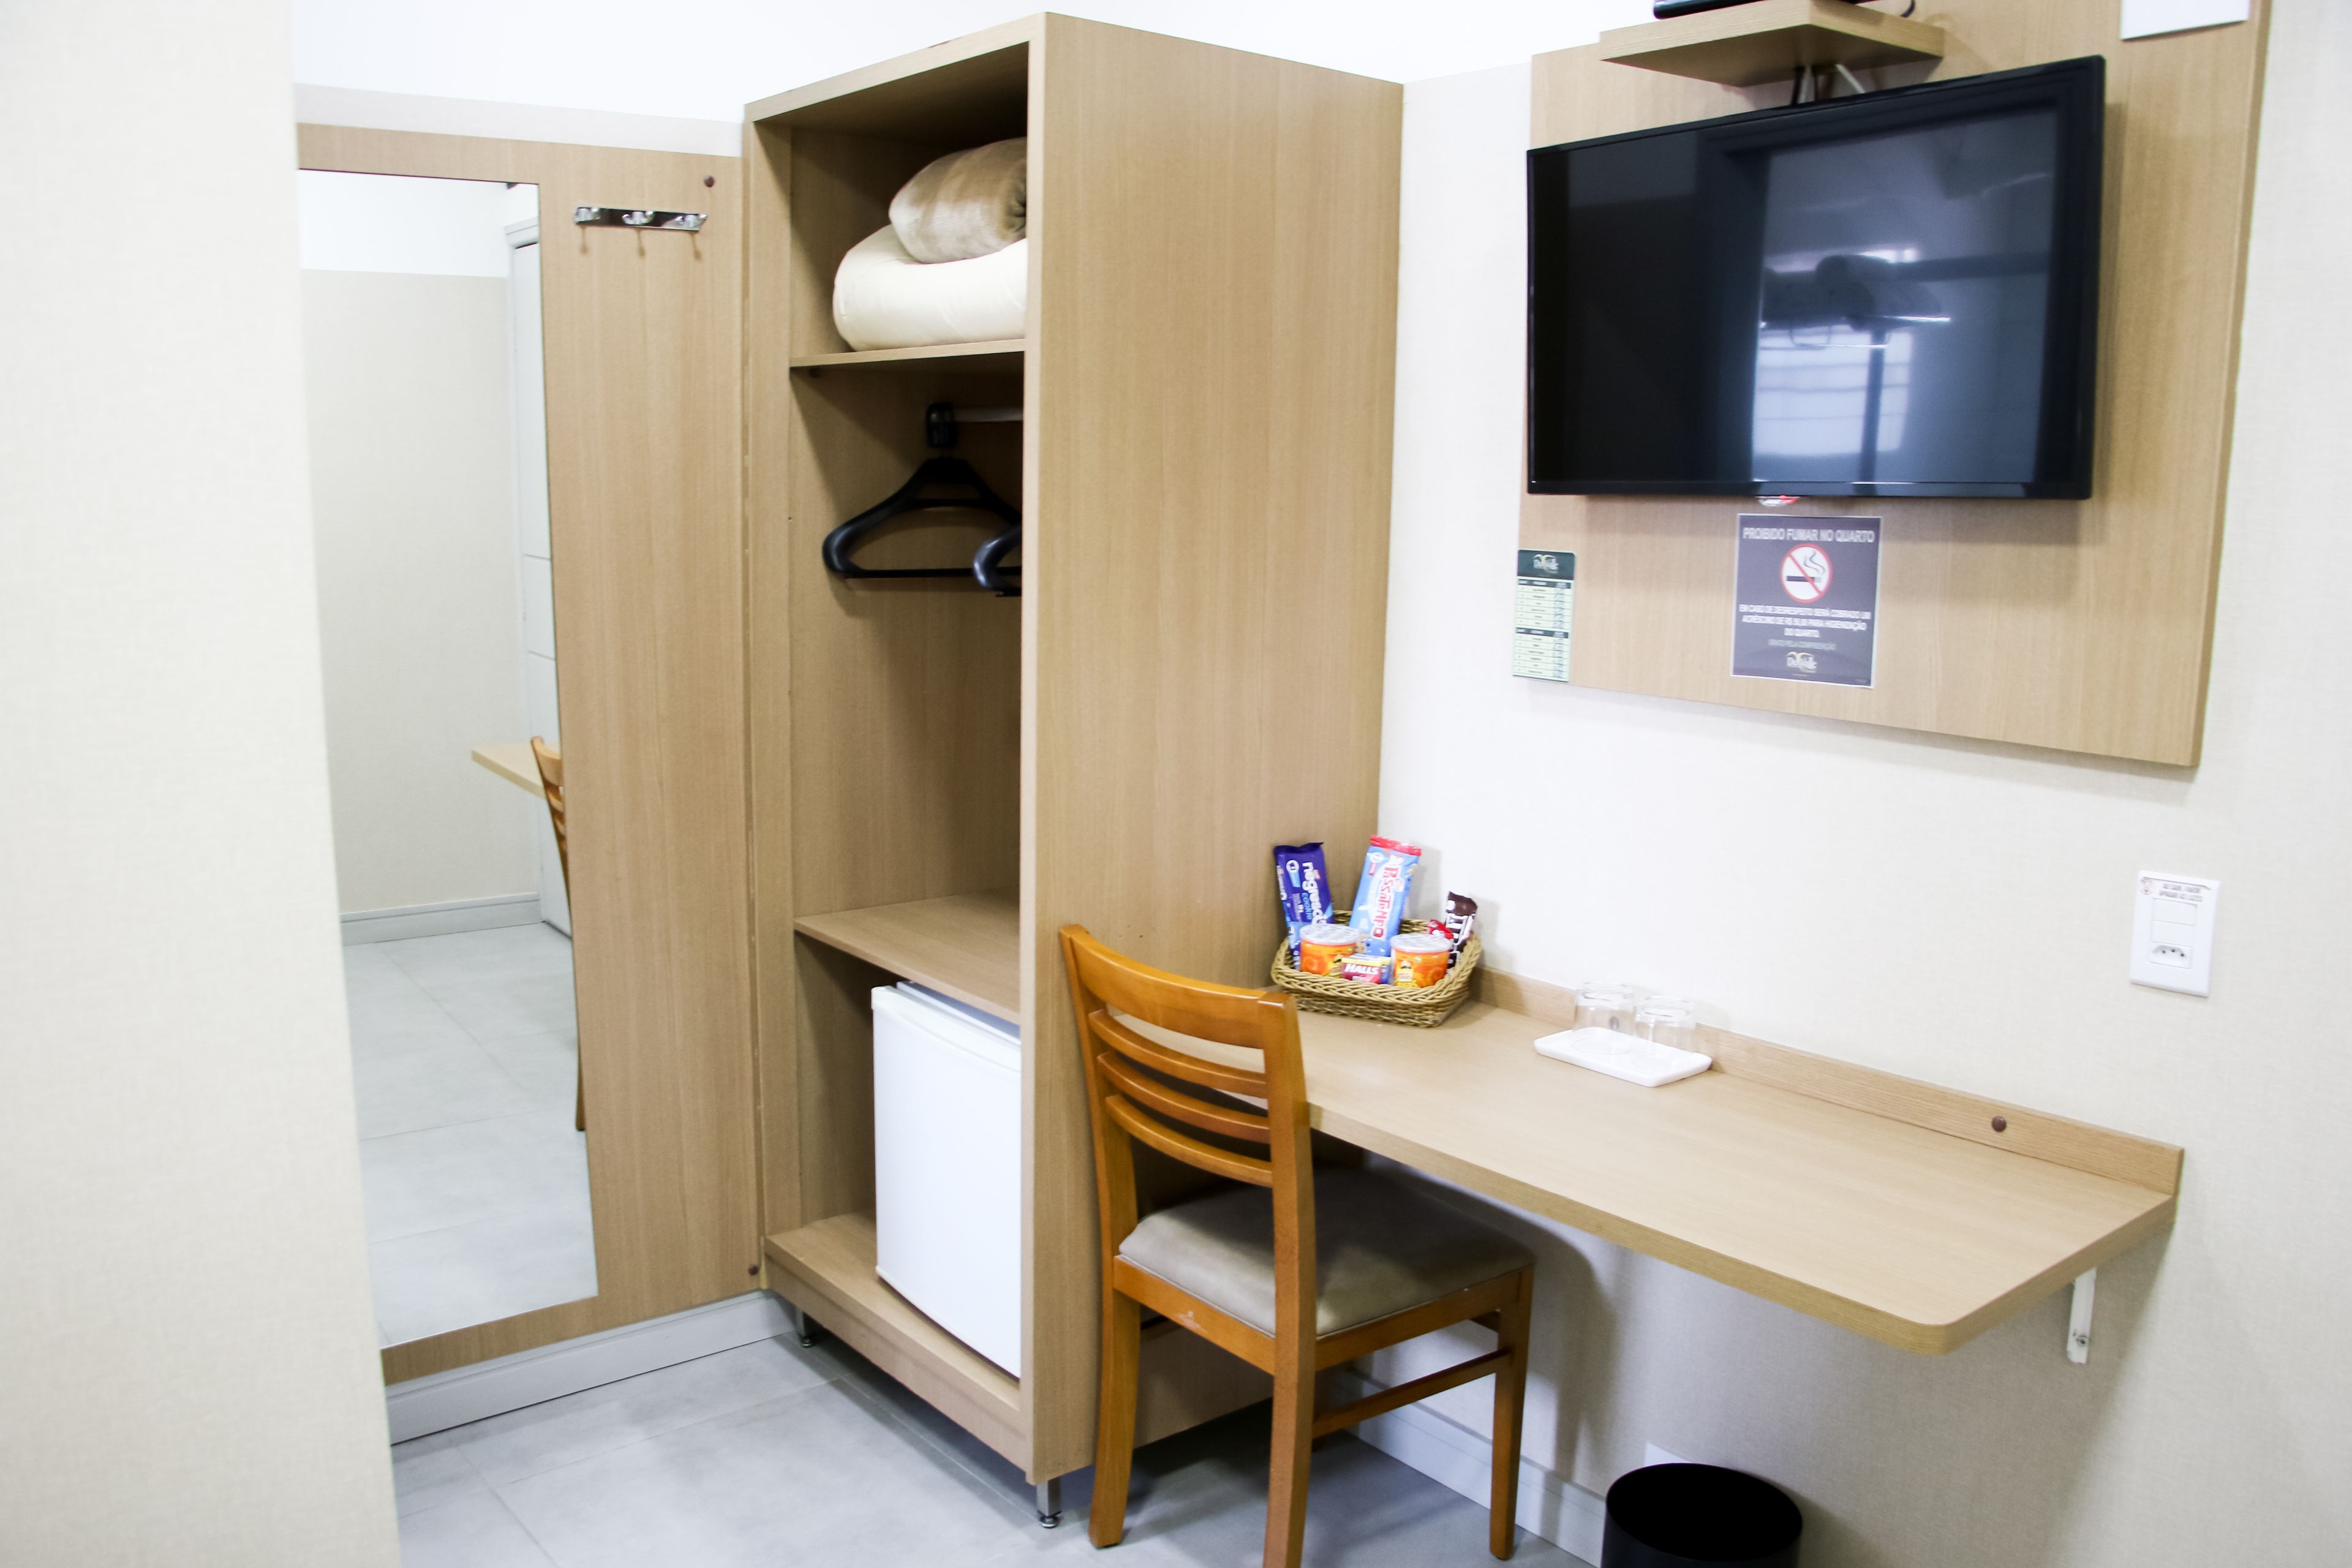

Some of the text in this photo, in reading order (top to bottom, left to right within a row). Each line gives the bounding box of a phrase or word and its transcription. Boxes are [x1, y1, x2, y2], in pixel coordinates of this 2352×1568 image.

[1743, 527, 1875, 543] PROIBIDO FUMAR NO QUARTO
[1344, 963, 1379, 975] HALLS
